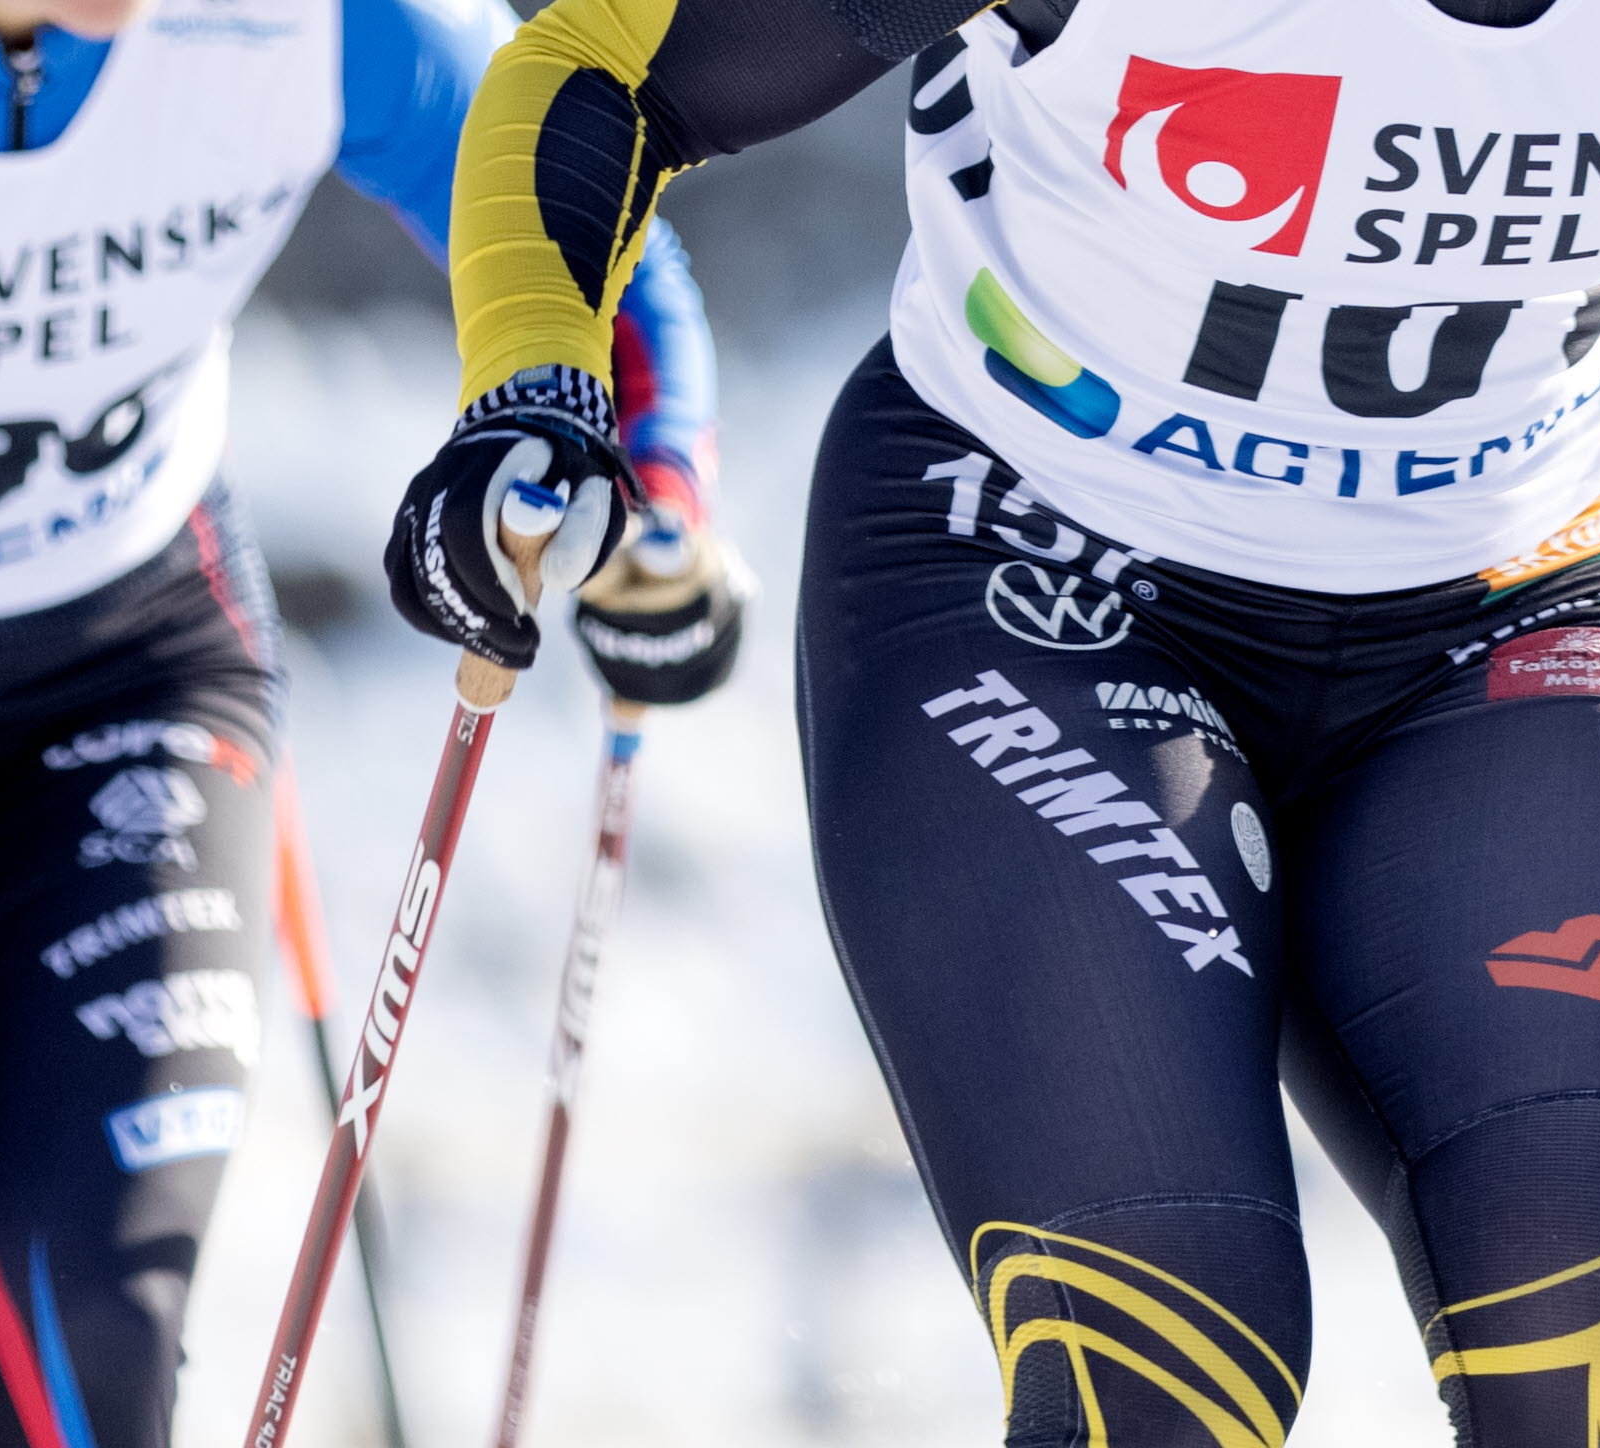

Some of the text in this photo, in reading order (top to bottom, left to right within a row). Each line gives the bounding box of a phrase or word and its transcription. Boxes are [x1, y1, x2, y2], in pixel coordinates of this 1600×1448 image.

[1344, 208, 1600, 267] SPEL
[1108, 717, 1173, 731] ERP
[921, 669, 1255, 978] TRIMTEX
[268, 1353, 297, 1422] TRIAC
